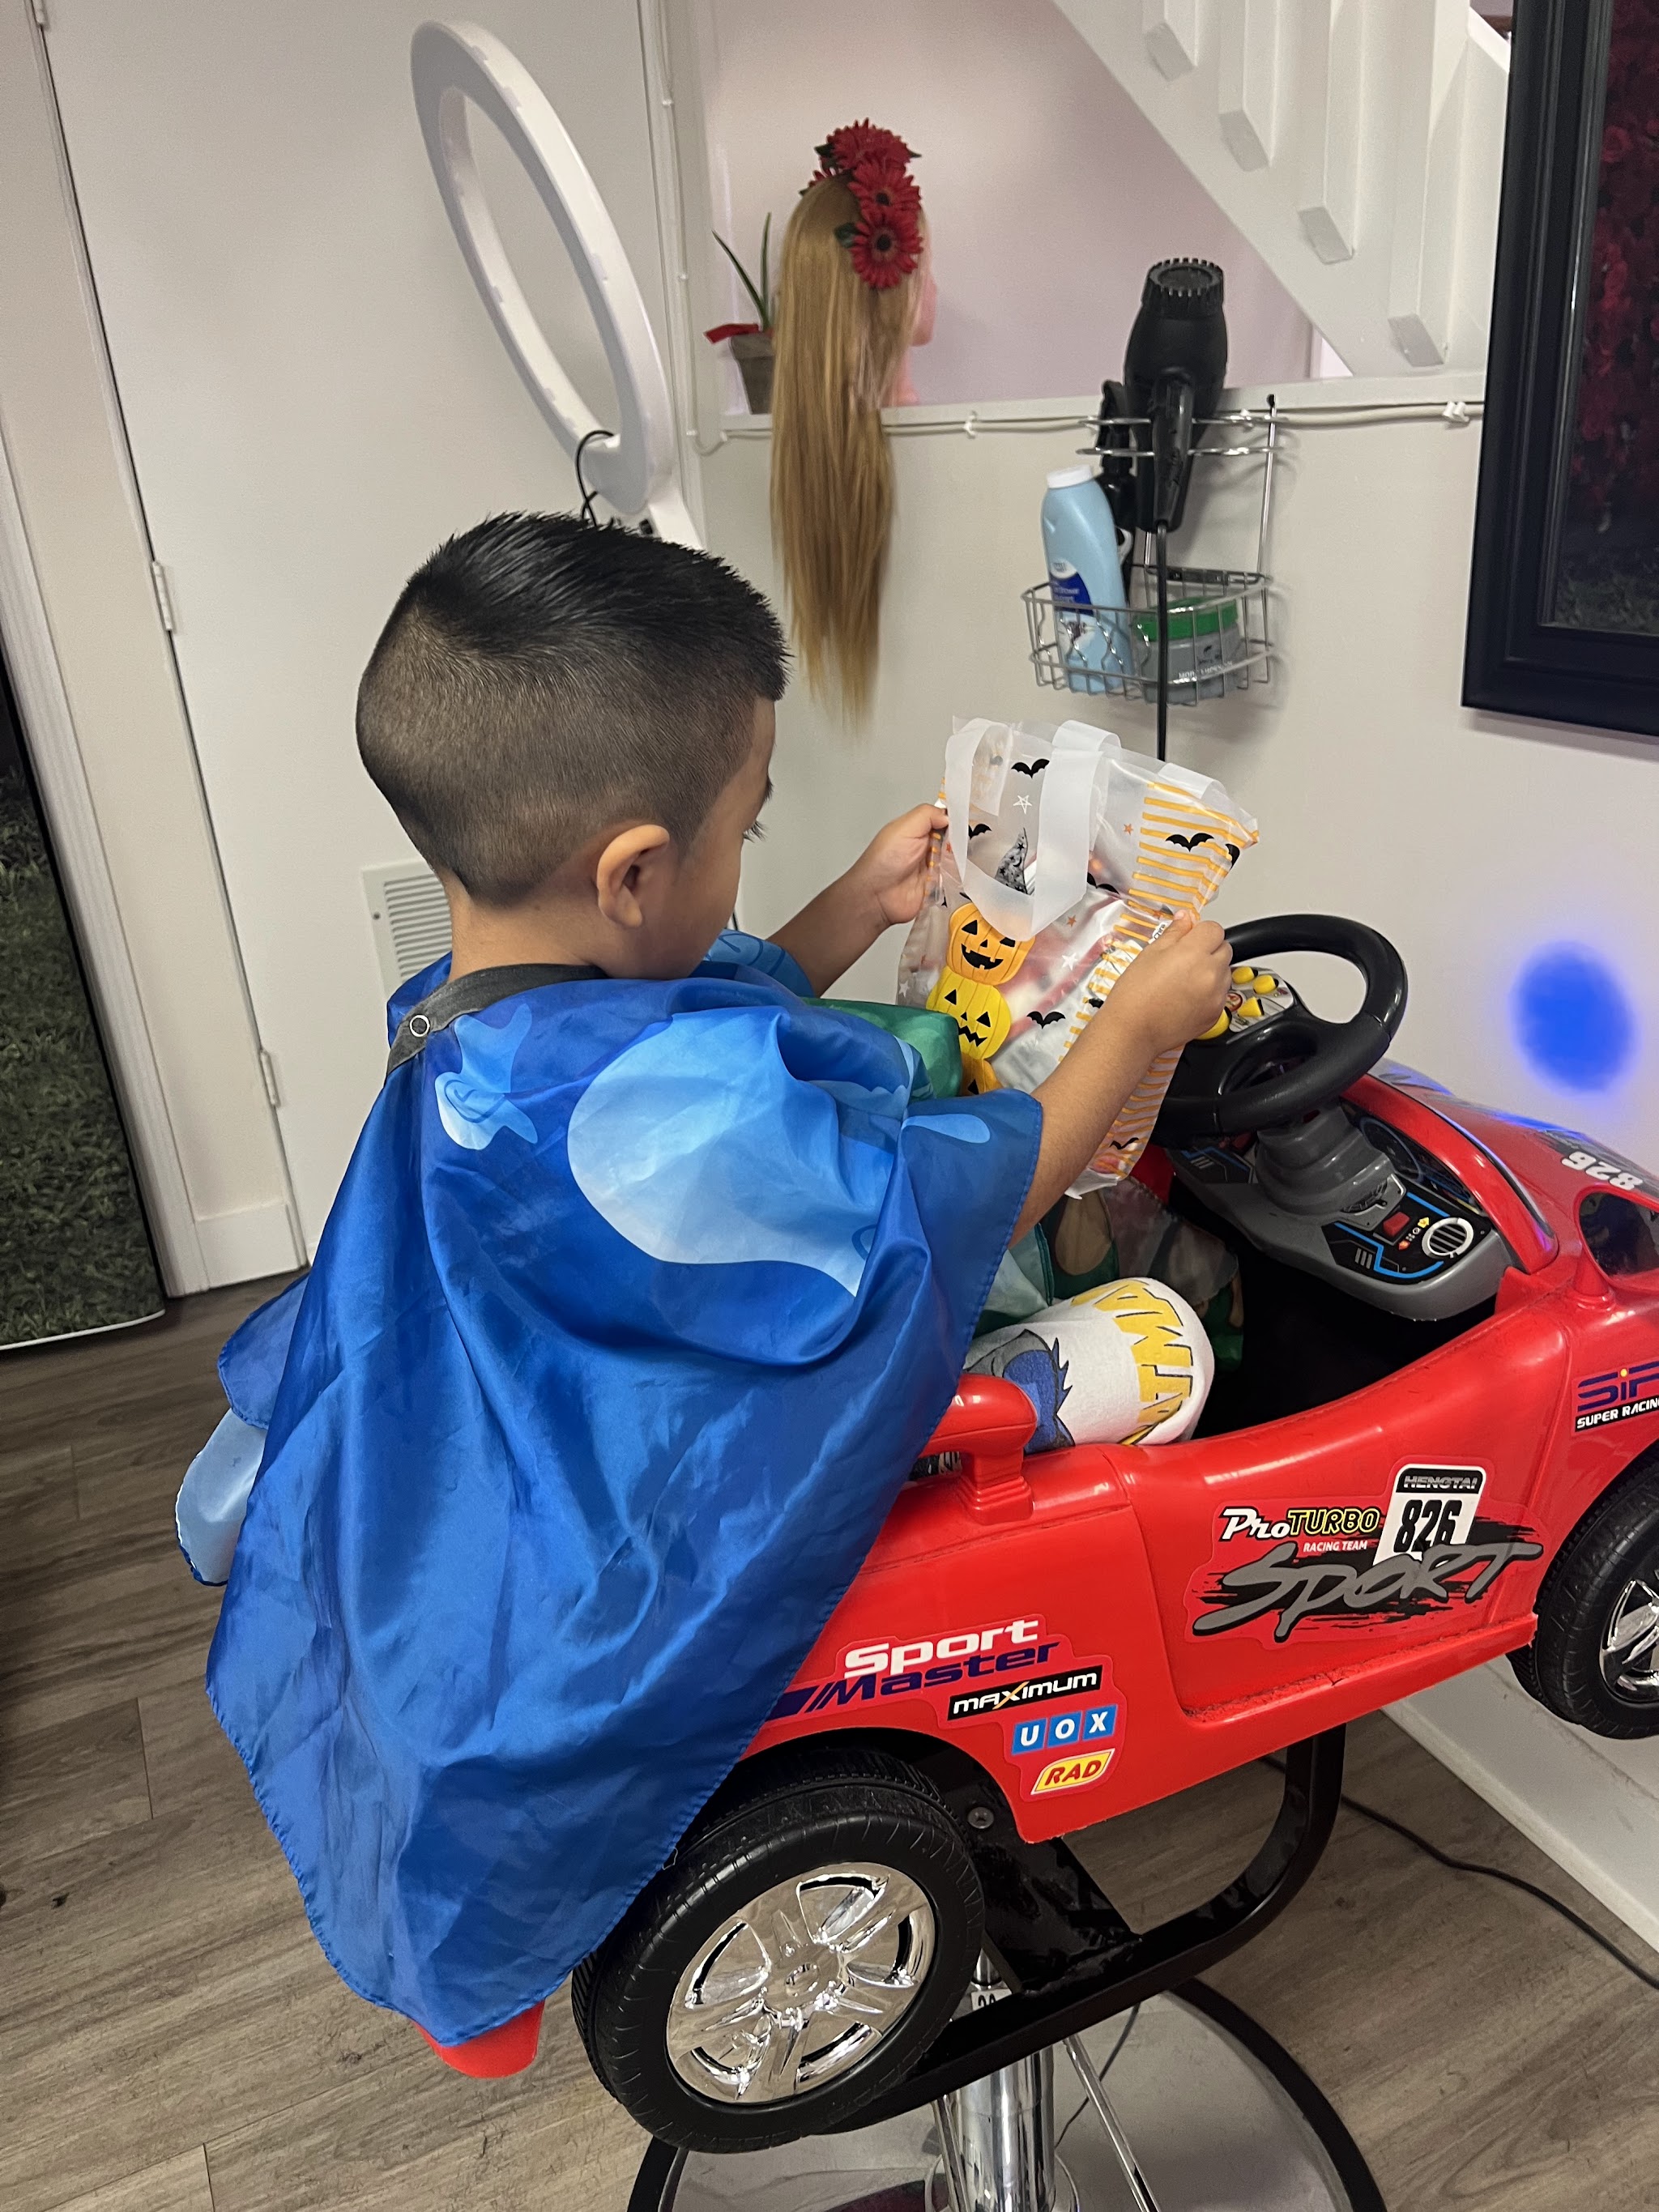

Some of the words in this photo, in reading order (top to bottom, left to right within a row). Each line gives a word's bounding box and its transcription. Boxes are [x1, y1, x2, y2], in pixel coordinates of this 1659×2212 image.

[1576, 1409, 1618, 1430] SUPER
[1623, 1397, 1659, 1417] RACIN
[1403, 1475, 1478, 1490] HENGTAI
[1303, 1541, 1340, 1553] RACING
[1341, 1540, 1368, 1551] TEAM
[1392, 1499, 1463, 1554] 826
[1192, 1541, 1543, 1643] SPORT
[843, 1619, 1039, 1679] Sport
[824, 1641, 1060, 1706] Master
[1043, 1759, 1103, 1787] RAD
